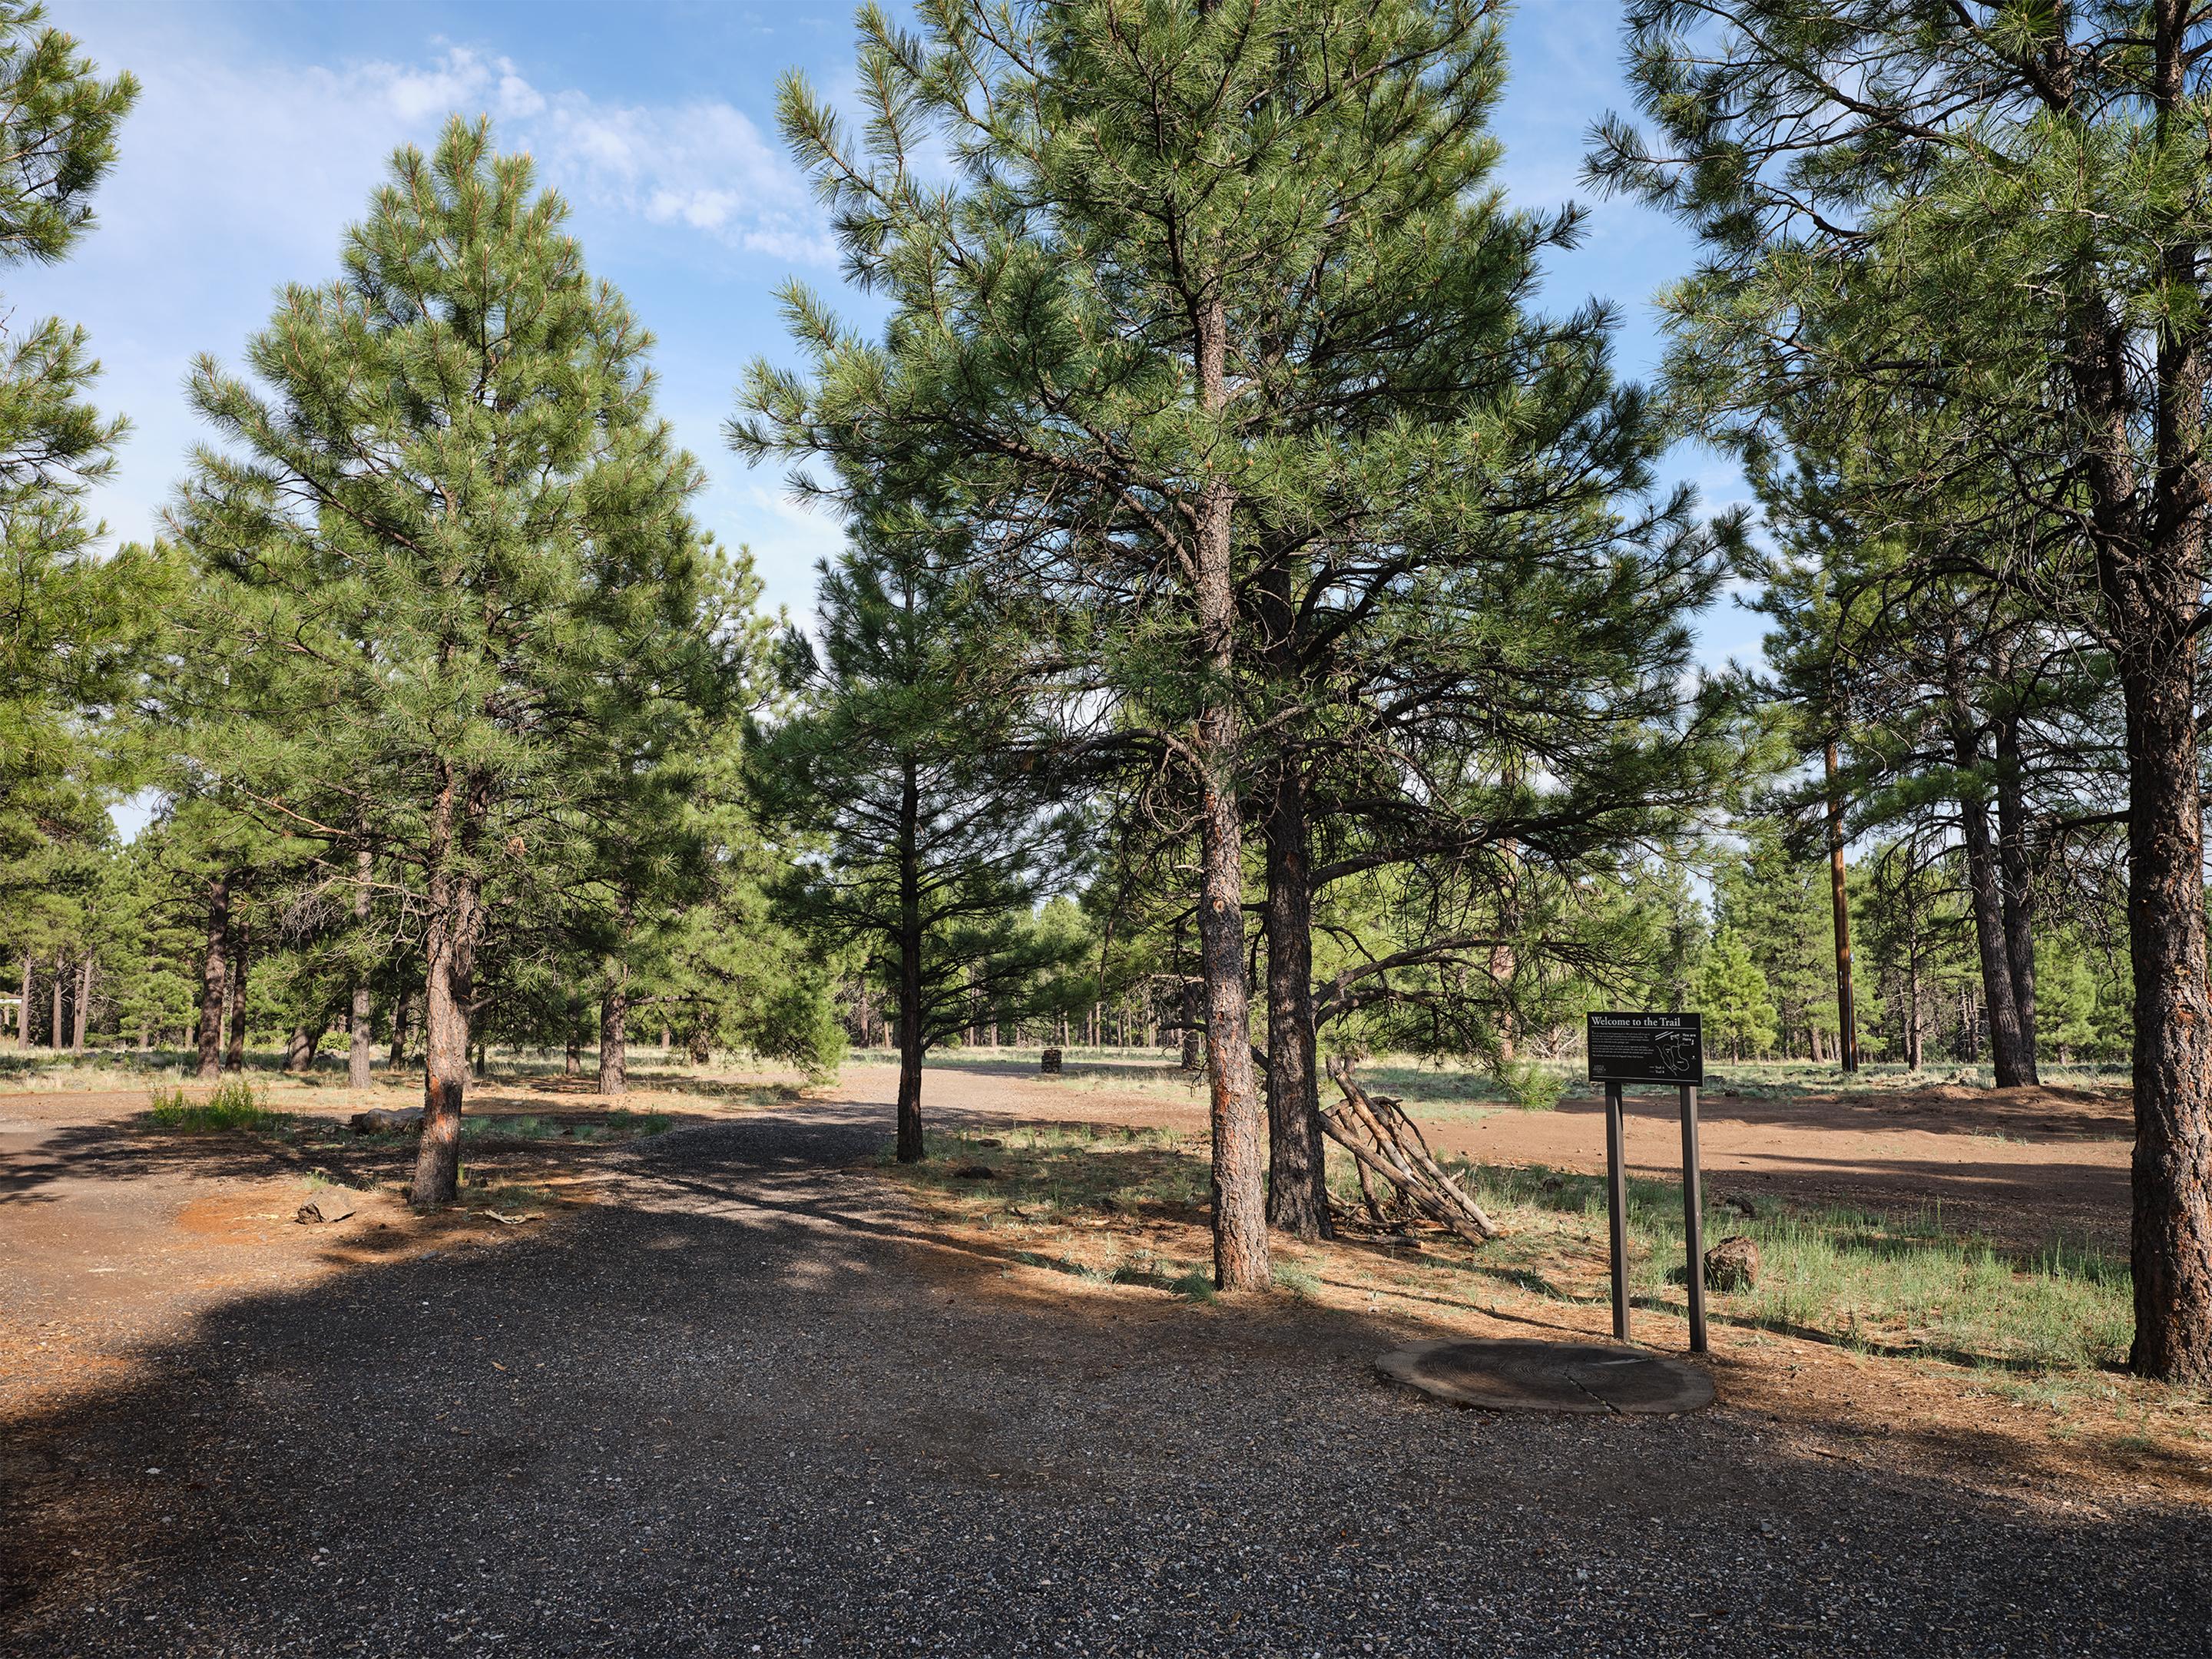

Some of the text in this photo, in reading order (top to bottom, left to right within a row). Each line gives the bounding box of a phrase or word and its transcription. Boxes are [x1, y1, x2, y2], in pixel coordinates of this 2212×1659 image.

[1591, 1016, 1630, 1025] Welcome
[1644, 1017, 1657, 1026] the
[1659, 1017, 1681, 1026] Trail
